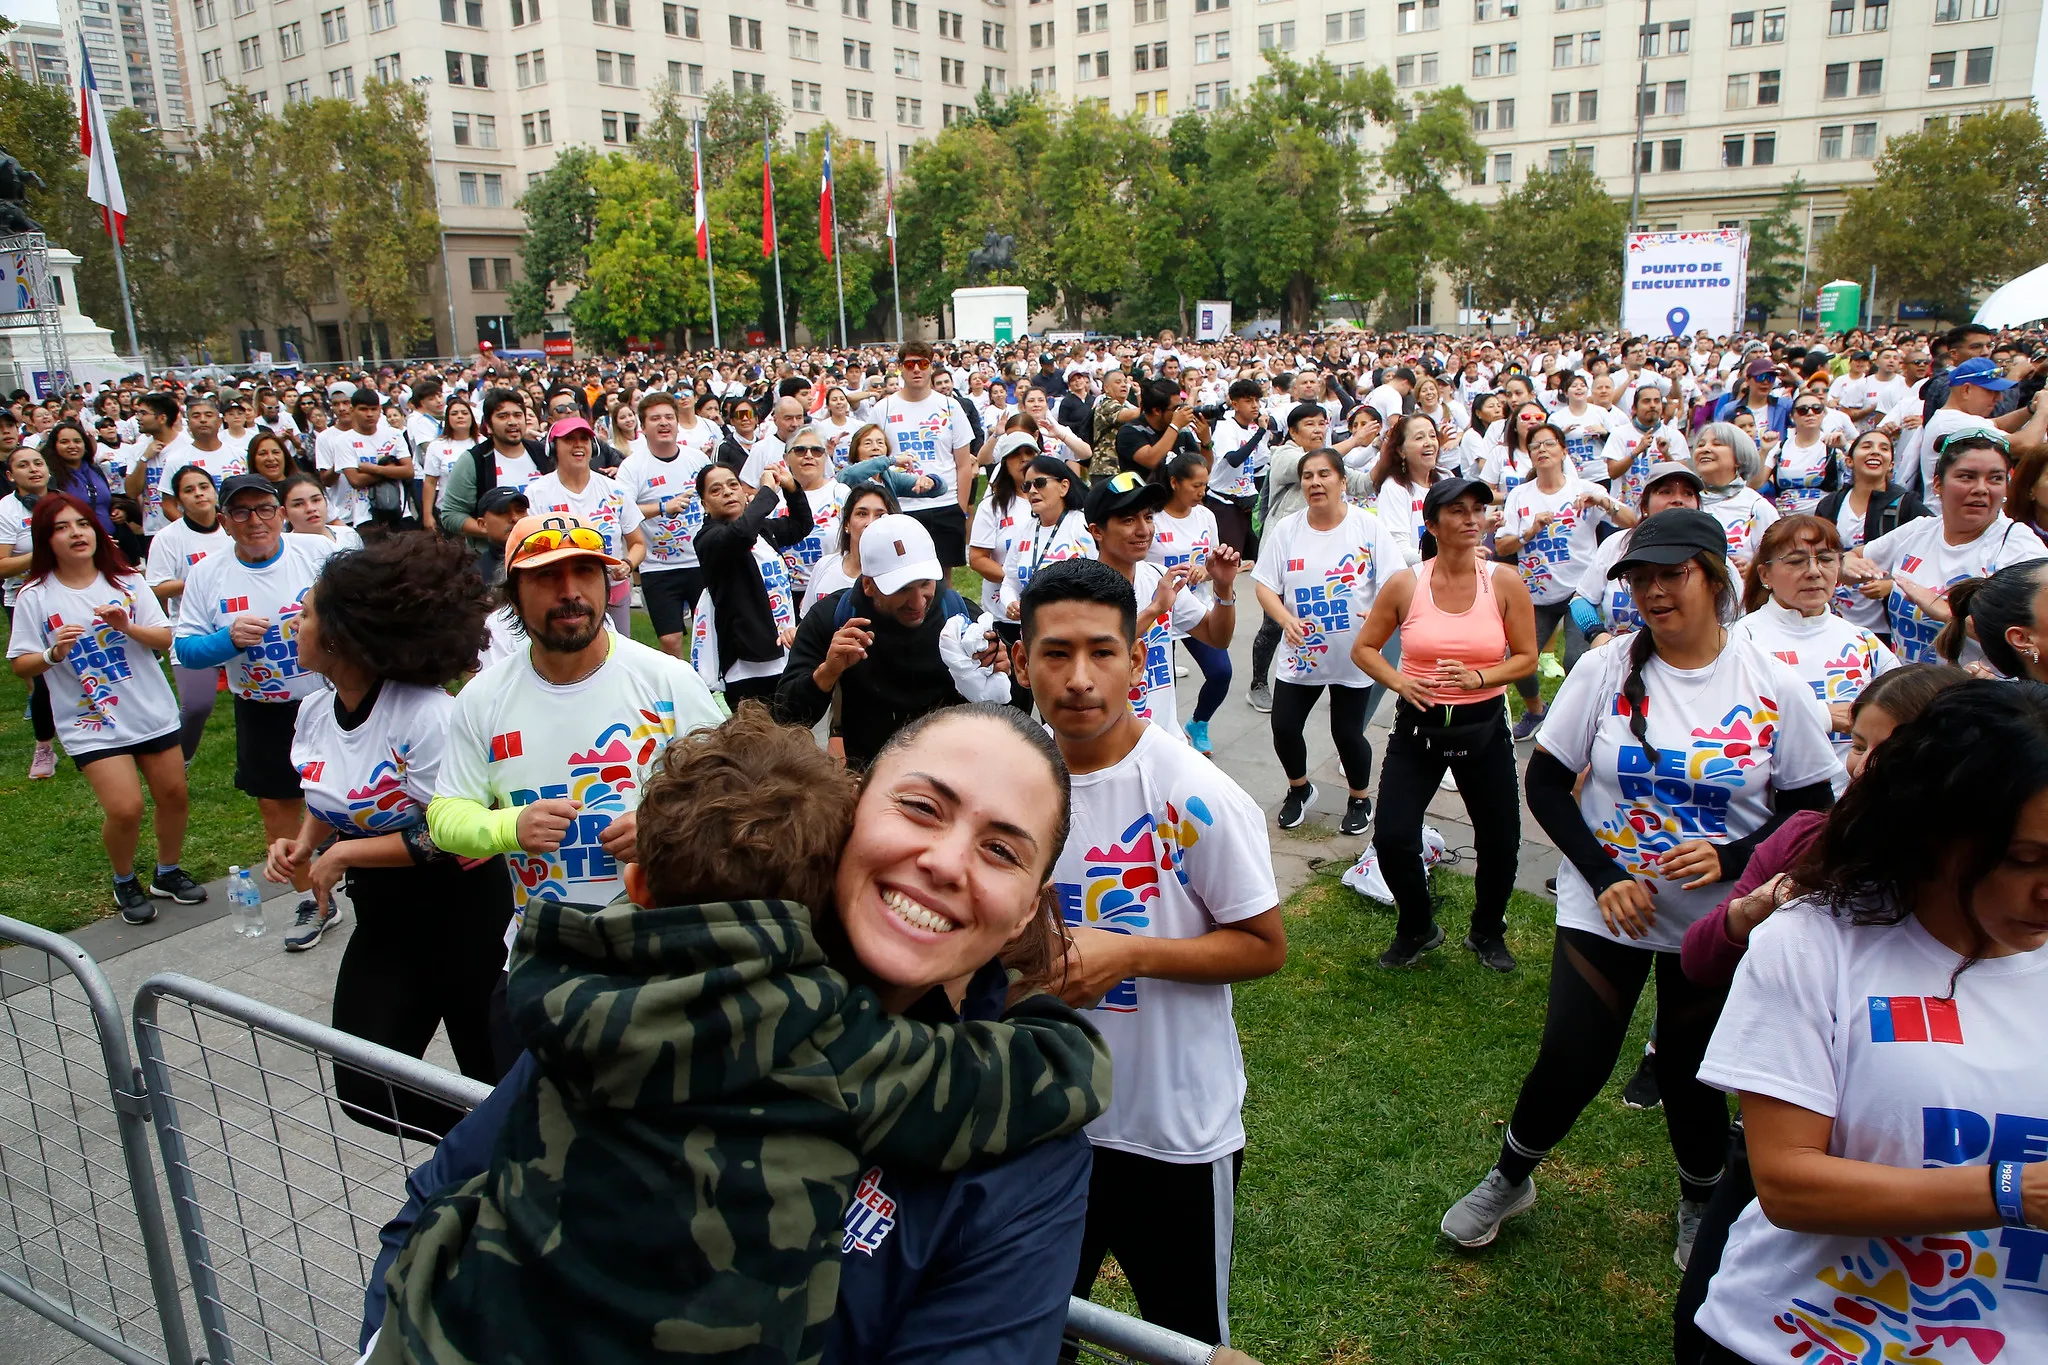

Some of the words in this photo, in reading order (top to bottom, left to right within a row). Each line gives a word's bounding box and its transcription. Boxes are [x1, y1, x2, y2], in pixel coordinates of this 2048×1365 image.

[1641, 263, 1697, 275] PUNTO
[1700, 262, 1722, 272] DE
[1631, 277, 1731, 290] ENCUENTRO
[897, 431, 919, 441] DE
[899, 440, 934, 452] POR
[918, 451, 936, 460] TE
[685, 513, 701, 525] TE
[1524, 537, 1569, 554] POR
[800, 551, 823, 564] TE
[1545, 548, 1571, 563] TE
[761, 561, 782, 576] DE
[1294, 585, 1326, 604] DE
[1296, 598, 1349, 619] POR
[1888, 591, 1918, 620] DE
[1320, 614, 1351, 632] TE
[69, 635, 100, 660] DE
[70, 646, 127, 676] POR
[101, 660, 133, 682] TE
[1617, 745, 1687, 779] DE
[1617, 774, 1732, 811] POR
[1672, 805, 1729, 834] TE
[559, 845, 617, 879] TE
[2001, 1163, 2014, 1193] 07864
